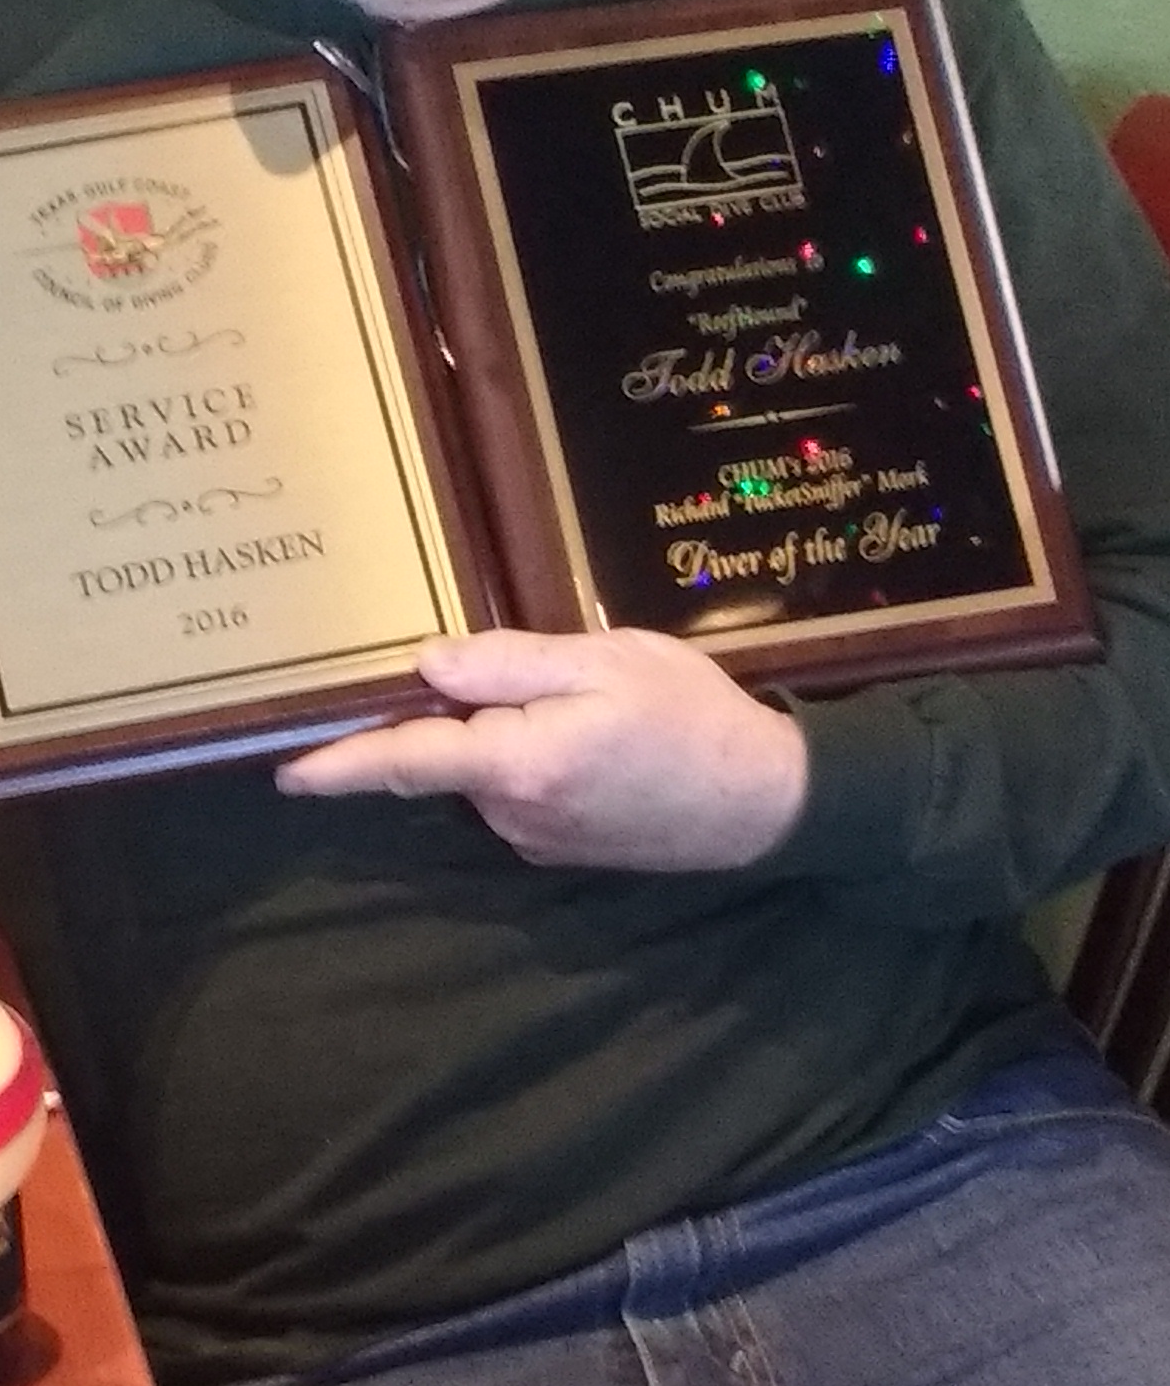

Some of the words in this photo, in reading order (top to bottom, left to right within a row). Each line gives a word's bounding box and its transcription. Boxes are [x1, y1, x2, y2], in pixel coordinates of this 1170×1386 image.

[621, 346, 737, 401] Todd
[64, 383, 257, 441] SERVICE
[90, 418, 252, 471] AWARD
[71, 556, 177, 598] TODD
[182, 528, 327, 579] HASKEN
[666, 538, 763, 589] Diver
[767, 530, 799, 586] of
[802, 526, 848, 566] the
[858, 506, 941, 563] Year
[177, 605, 250, 637] 2016
